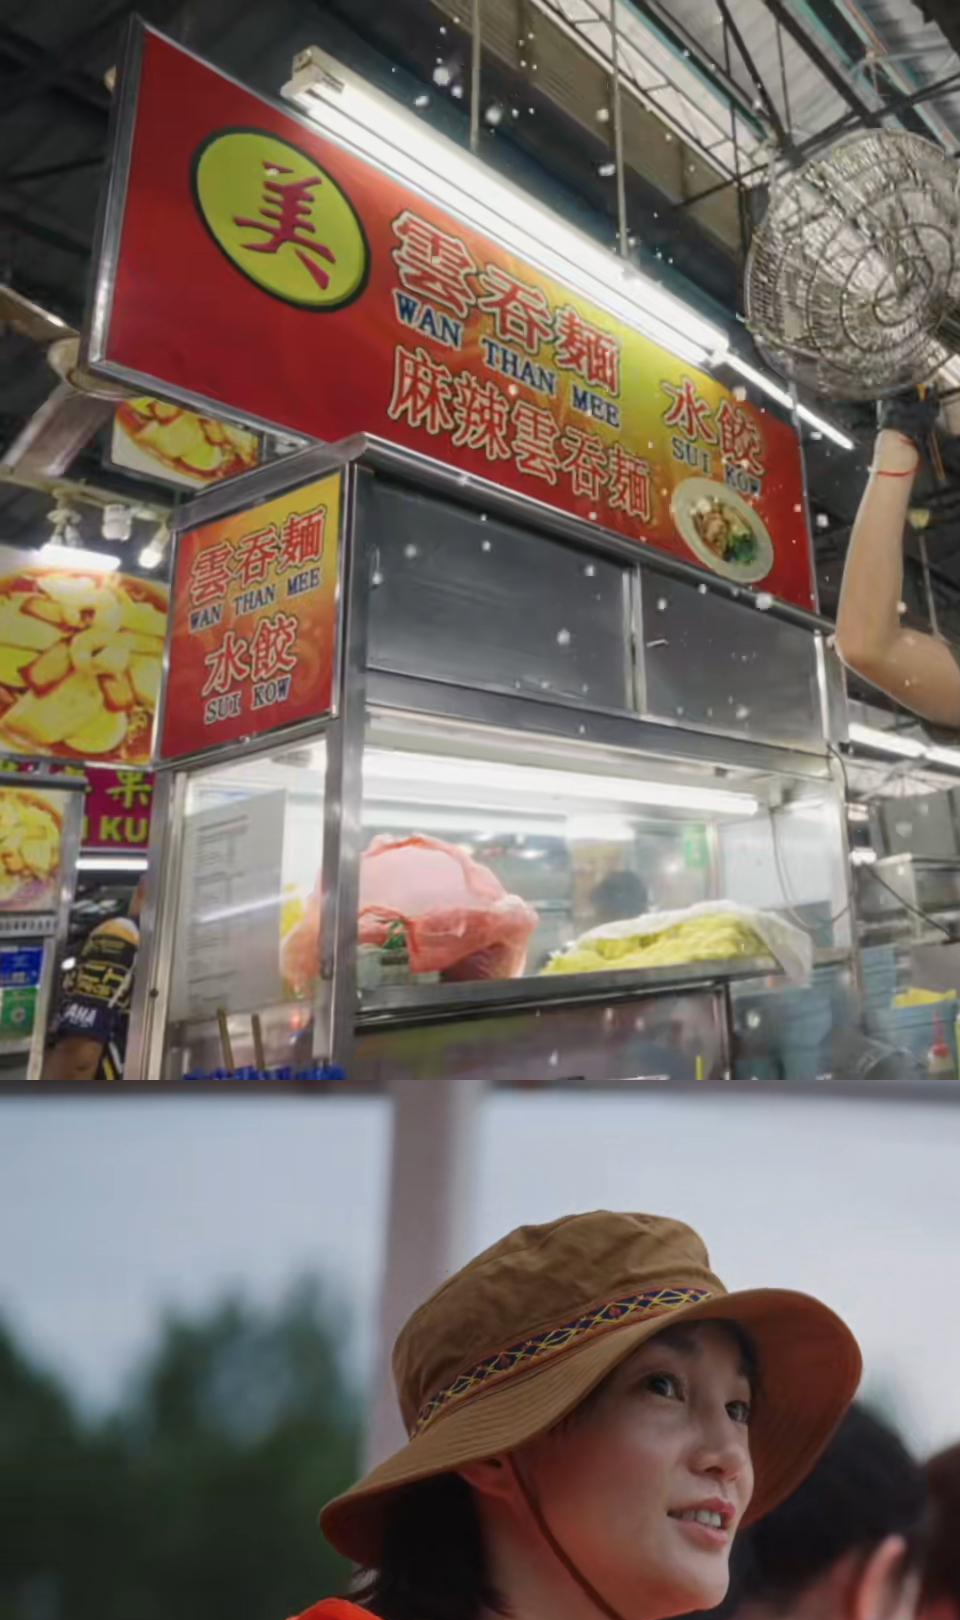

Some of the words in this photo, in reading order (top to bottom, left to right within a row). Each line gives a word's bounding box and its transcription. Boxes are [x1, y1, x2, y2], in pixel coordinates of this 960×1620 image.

[232, 160, 336, 290] 美
[391, 210, 621, 397] 雲吞麵
[393, 289, 463, 351] WAN
[481, 338, 556, 397] THAN
[570, 382, 621, 428] MEE
[388, 345, 653, 522] 麻辣雲吞麵
[660, 377, 764, 477] 水餃
[672, 436, 711, 478] SUI
[725, 464, 762, 498] KOW
[189, 504, 327, 606] 雲吞麵
[189, 604, 222, 633] WAN
[233, 584, 277, 617] THAN
[287, 567, 321, 597] MEE
[202, 613, 298, 697] 水餃
[204, 692, 241, 725] SUI
[251, 676, 291, 710] KOW
